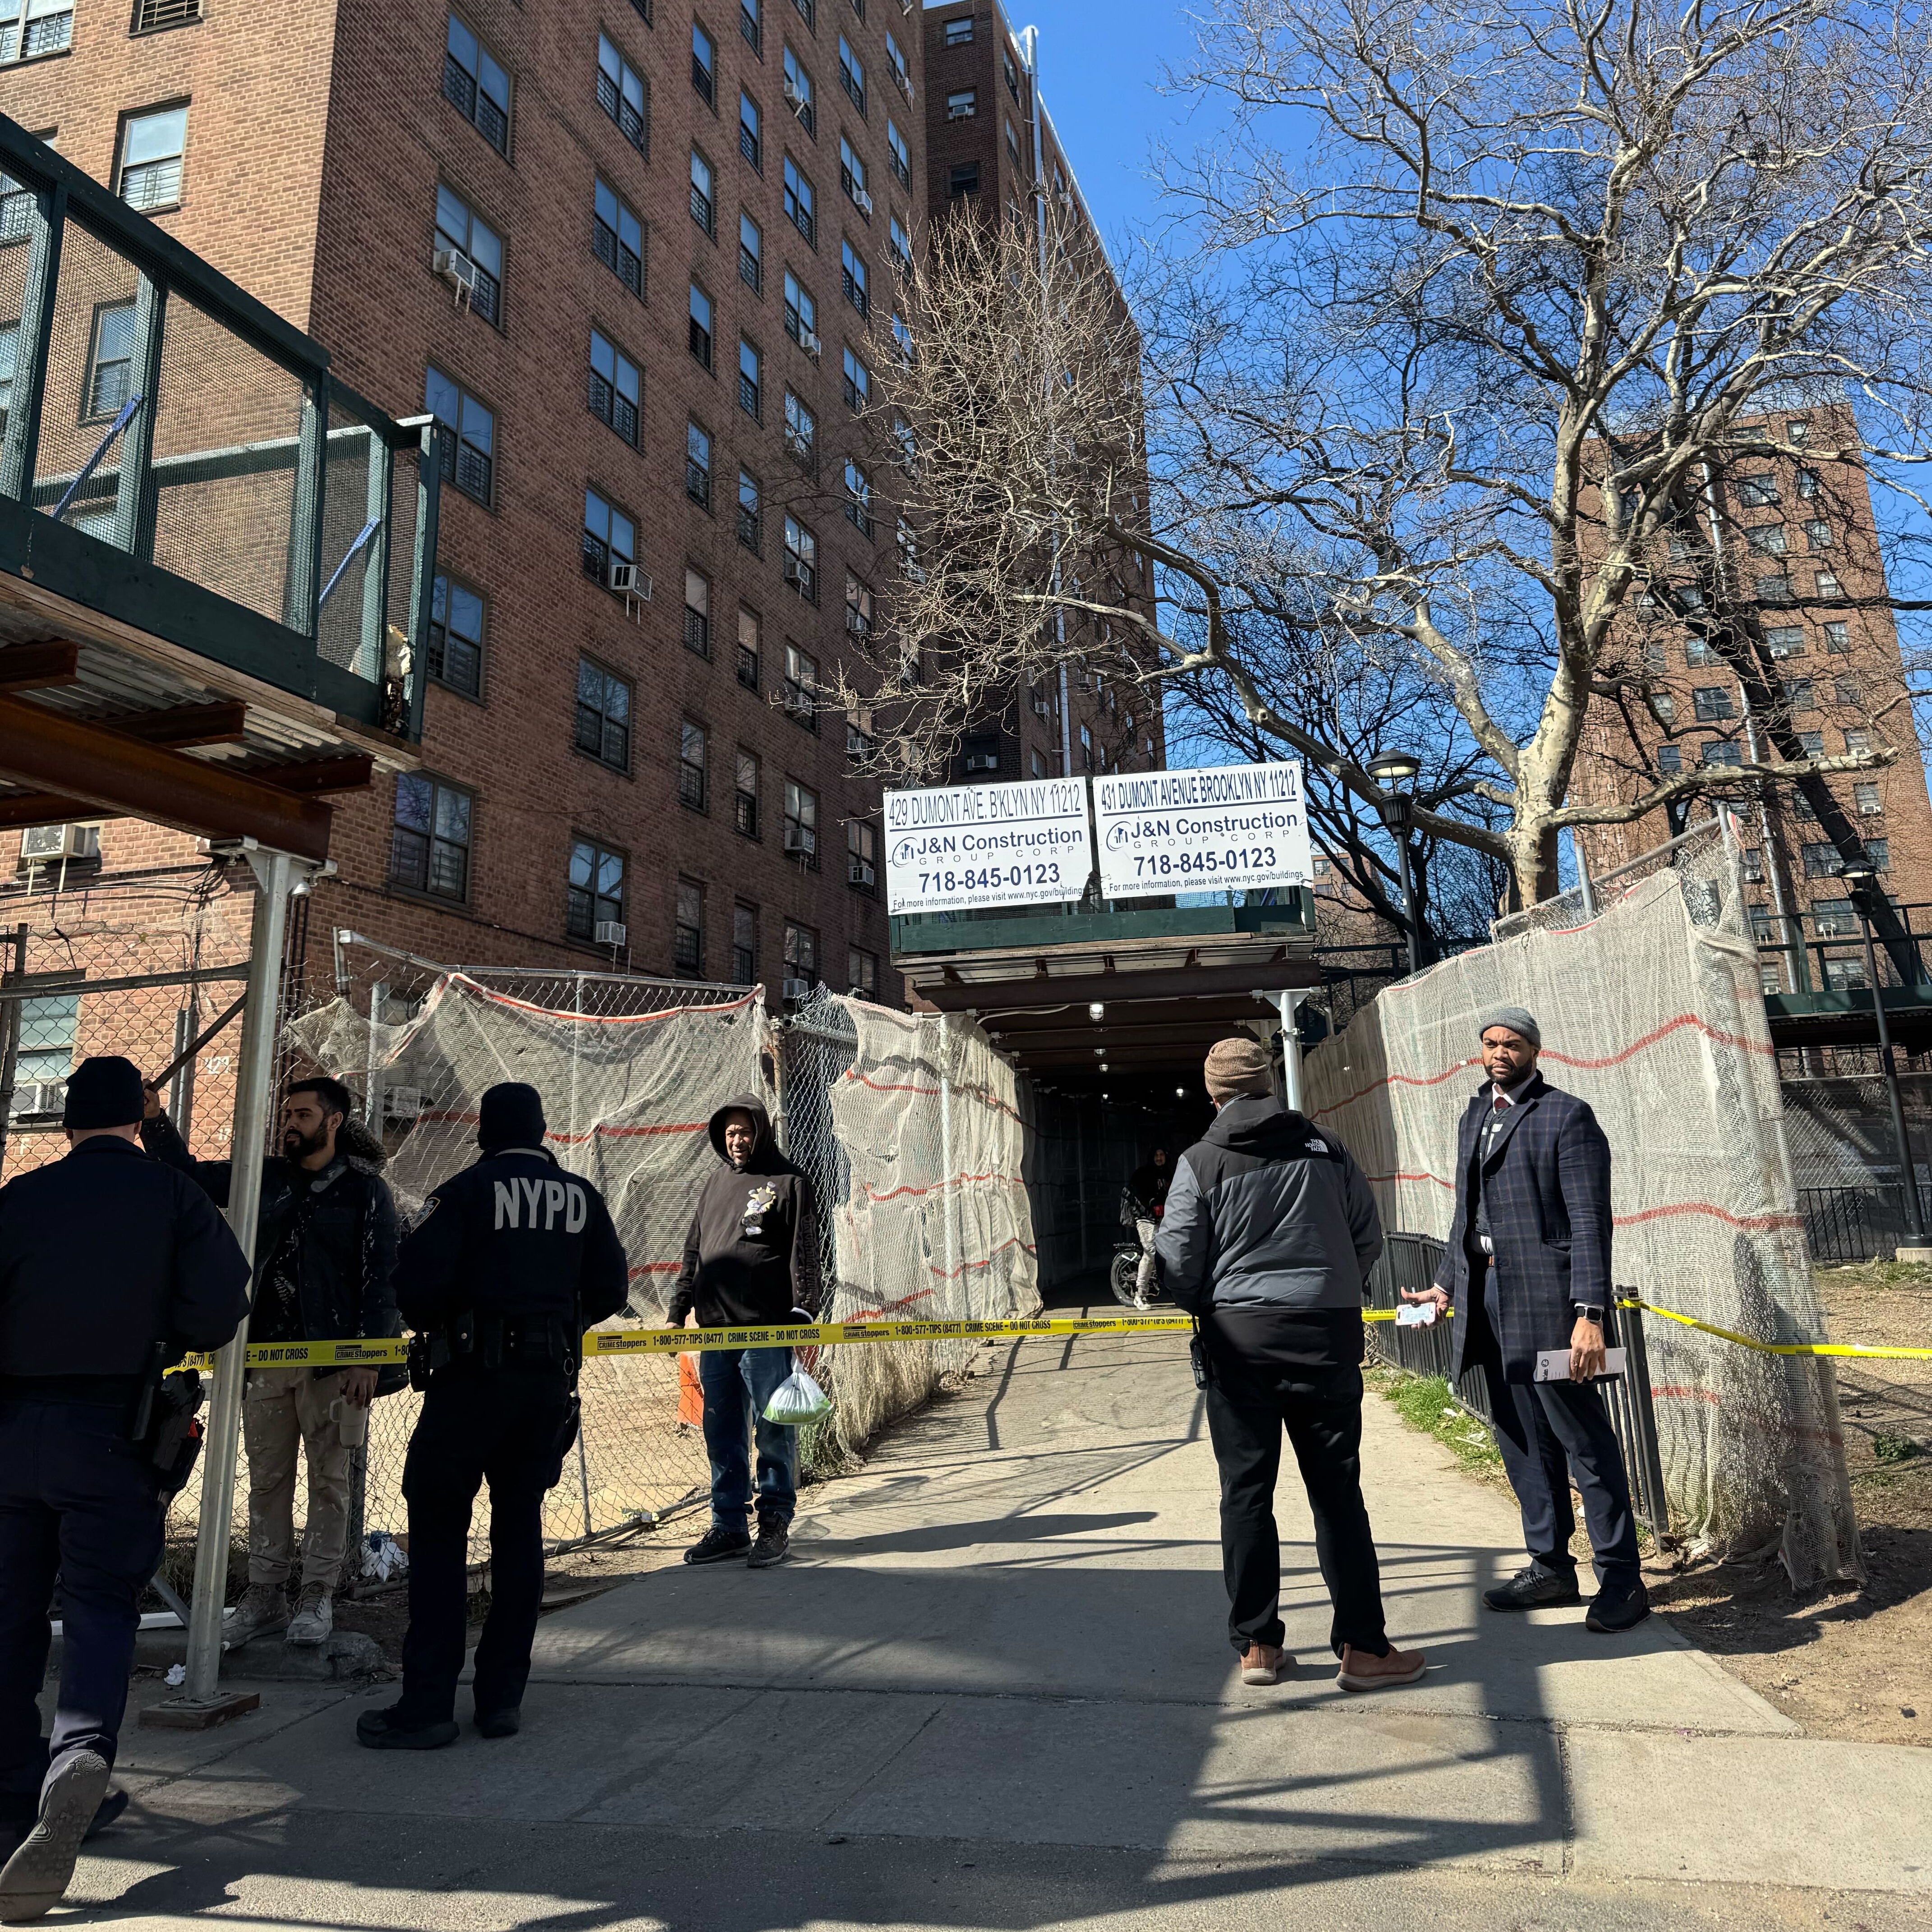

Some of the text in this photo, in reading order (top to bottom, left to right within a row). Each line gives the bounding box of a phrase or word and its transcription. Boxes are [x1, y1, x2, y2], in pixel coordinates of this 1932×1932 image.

[1101, 768, 1296, 810] 431 DUMONT AVENUE BROOKLYN NY 11212
[889, 784, 1081, 826] 429 DUMONT AVE. B'KLYN NY 11212
[1131, 812, 1297, 838] J&N Construction
[917, 827, 1082, 855] J&N Construction
[1134, 836, 1209, 848] GROUP
[919, 852, 994, 865] GROUP
[1134, 846, 1276, 876] 718-845-0123
[919, 863, 1060, 893] 718-845-0123
[1109, 870, 1303, 892] For more information, please visit www.nyc.gov/buildings
[925, 895, 966, 906] information,
[968, 894, 990, 905] please
[992, 892, 1006, 901] visit
[494, 1178, 587, 1233] NYPD
[653, 1333, 702, 1346] 1-800-577-TIPS
[704, 1331, 724, 1345] (8477)
[728, 1332, 748, 1343] CRIME
[749, 1331, 769, 1342] SCENE
[776, 1330, 785, 1341] DO
[787, 1329, 798, 1340] NOT
[800, 1329, 820, 1339] CROSS
[895, 1324, 942, 1335] 1-800-577-TIPS
[943, 1323, 961, 1334] (8477)
[965, 1322, 984, 1333] CRIME
[985, 1322, 1004, 1332] SCENE
[1010, 1321, 1018, 1330] DO
[1019, 1320, 1030, 1330] NOT
[1031, 1320, 1051, 1329] CROSS
[258, 1349, 268, 1362] DO
[269, 1348, 284, 1361] NOT
[285, 1348, 308, 1361] CROSS
